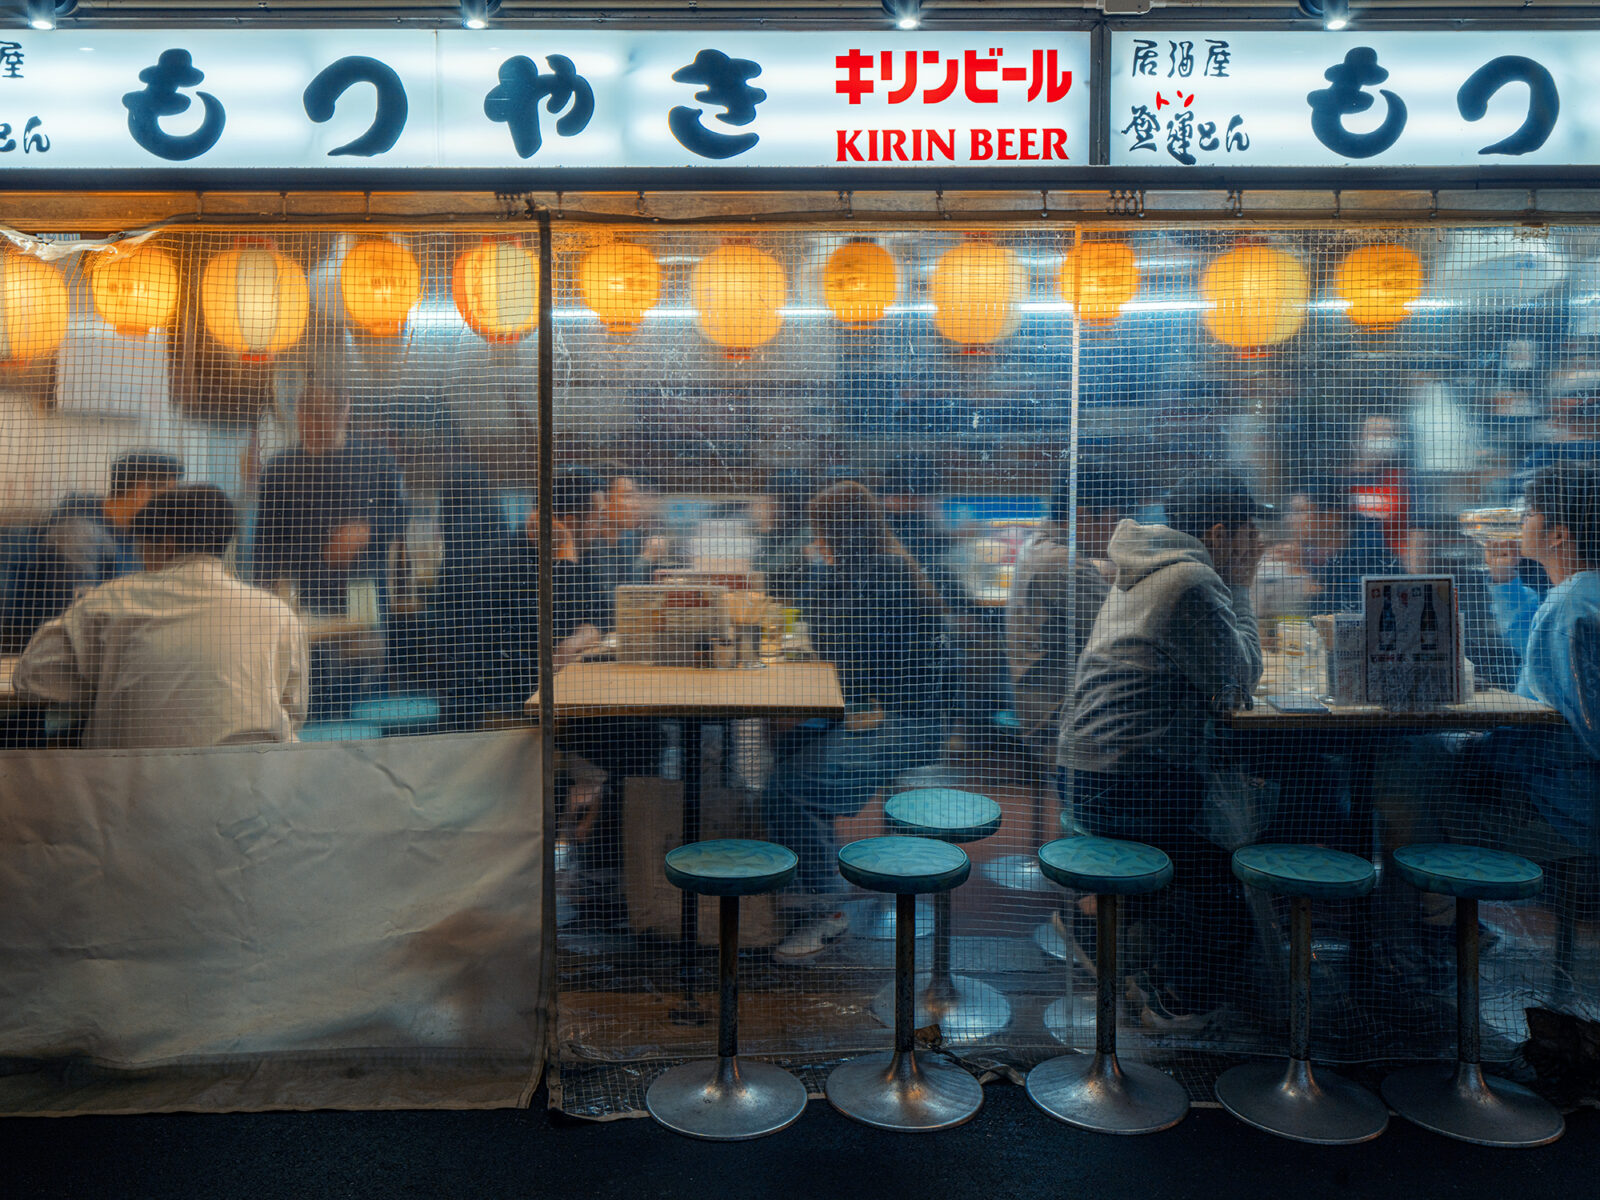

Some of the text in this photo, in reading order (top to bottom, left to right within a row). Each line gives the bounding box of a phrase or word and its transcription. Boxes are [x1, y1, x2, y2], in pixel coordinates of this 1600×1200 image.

[836, 49, 1073, 105] キリンビール
[1132, 39, 1231, 78] 居酒屋
[123, 48, 766, 161] もつやき
[1307, 47, 1560, 159] もつ
[837, 129, 1069, 161] KIRIN BEER
